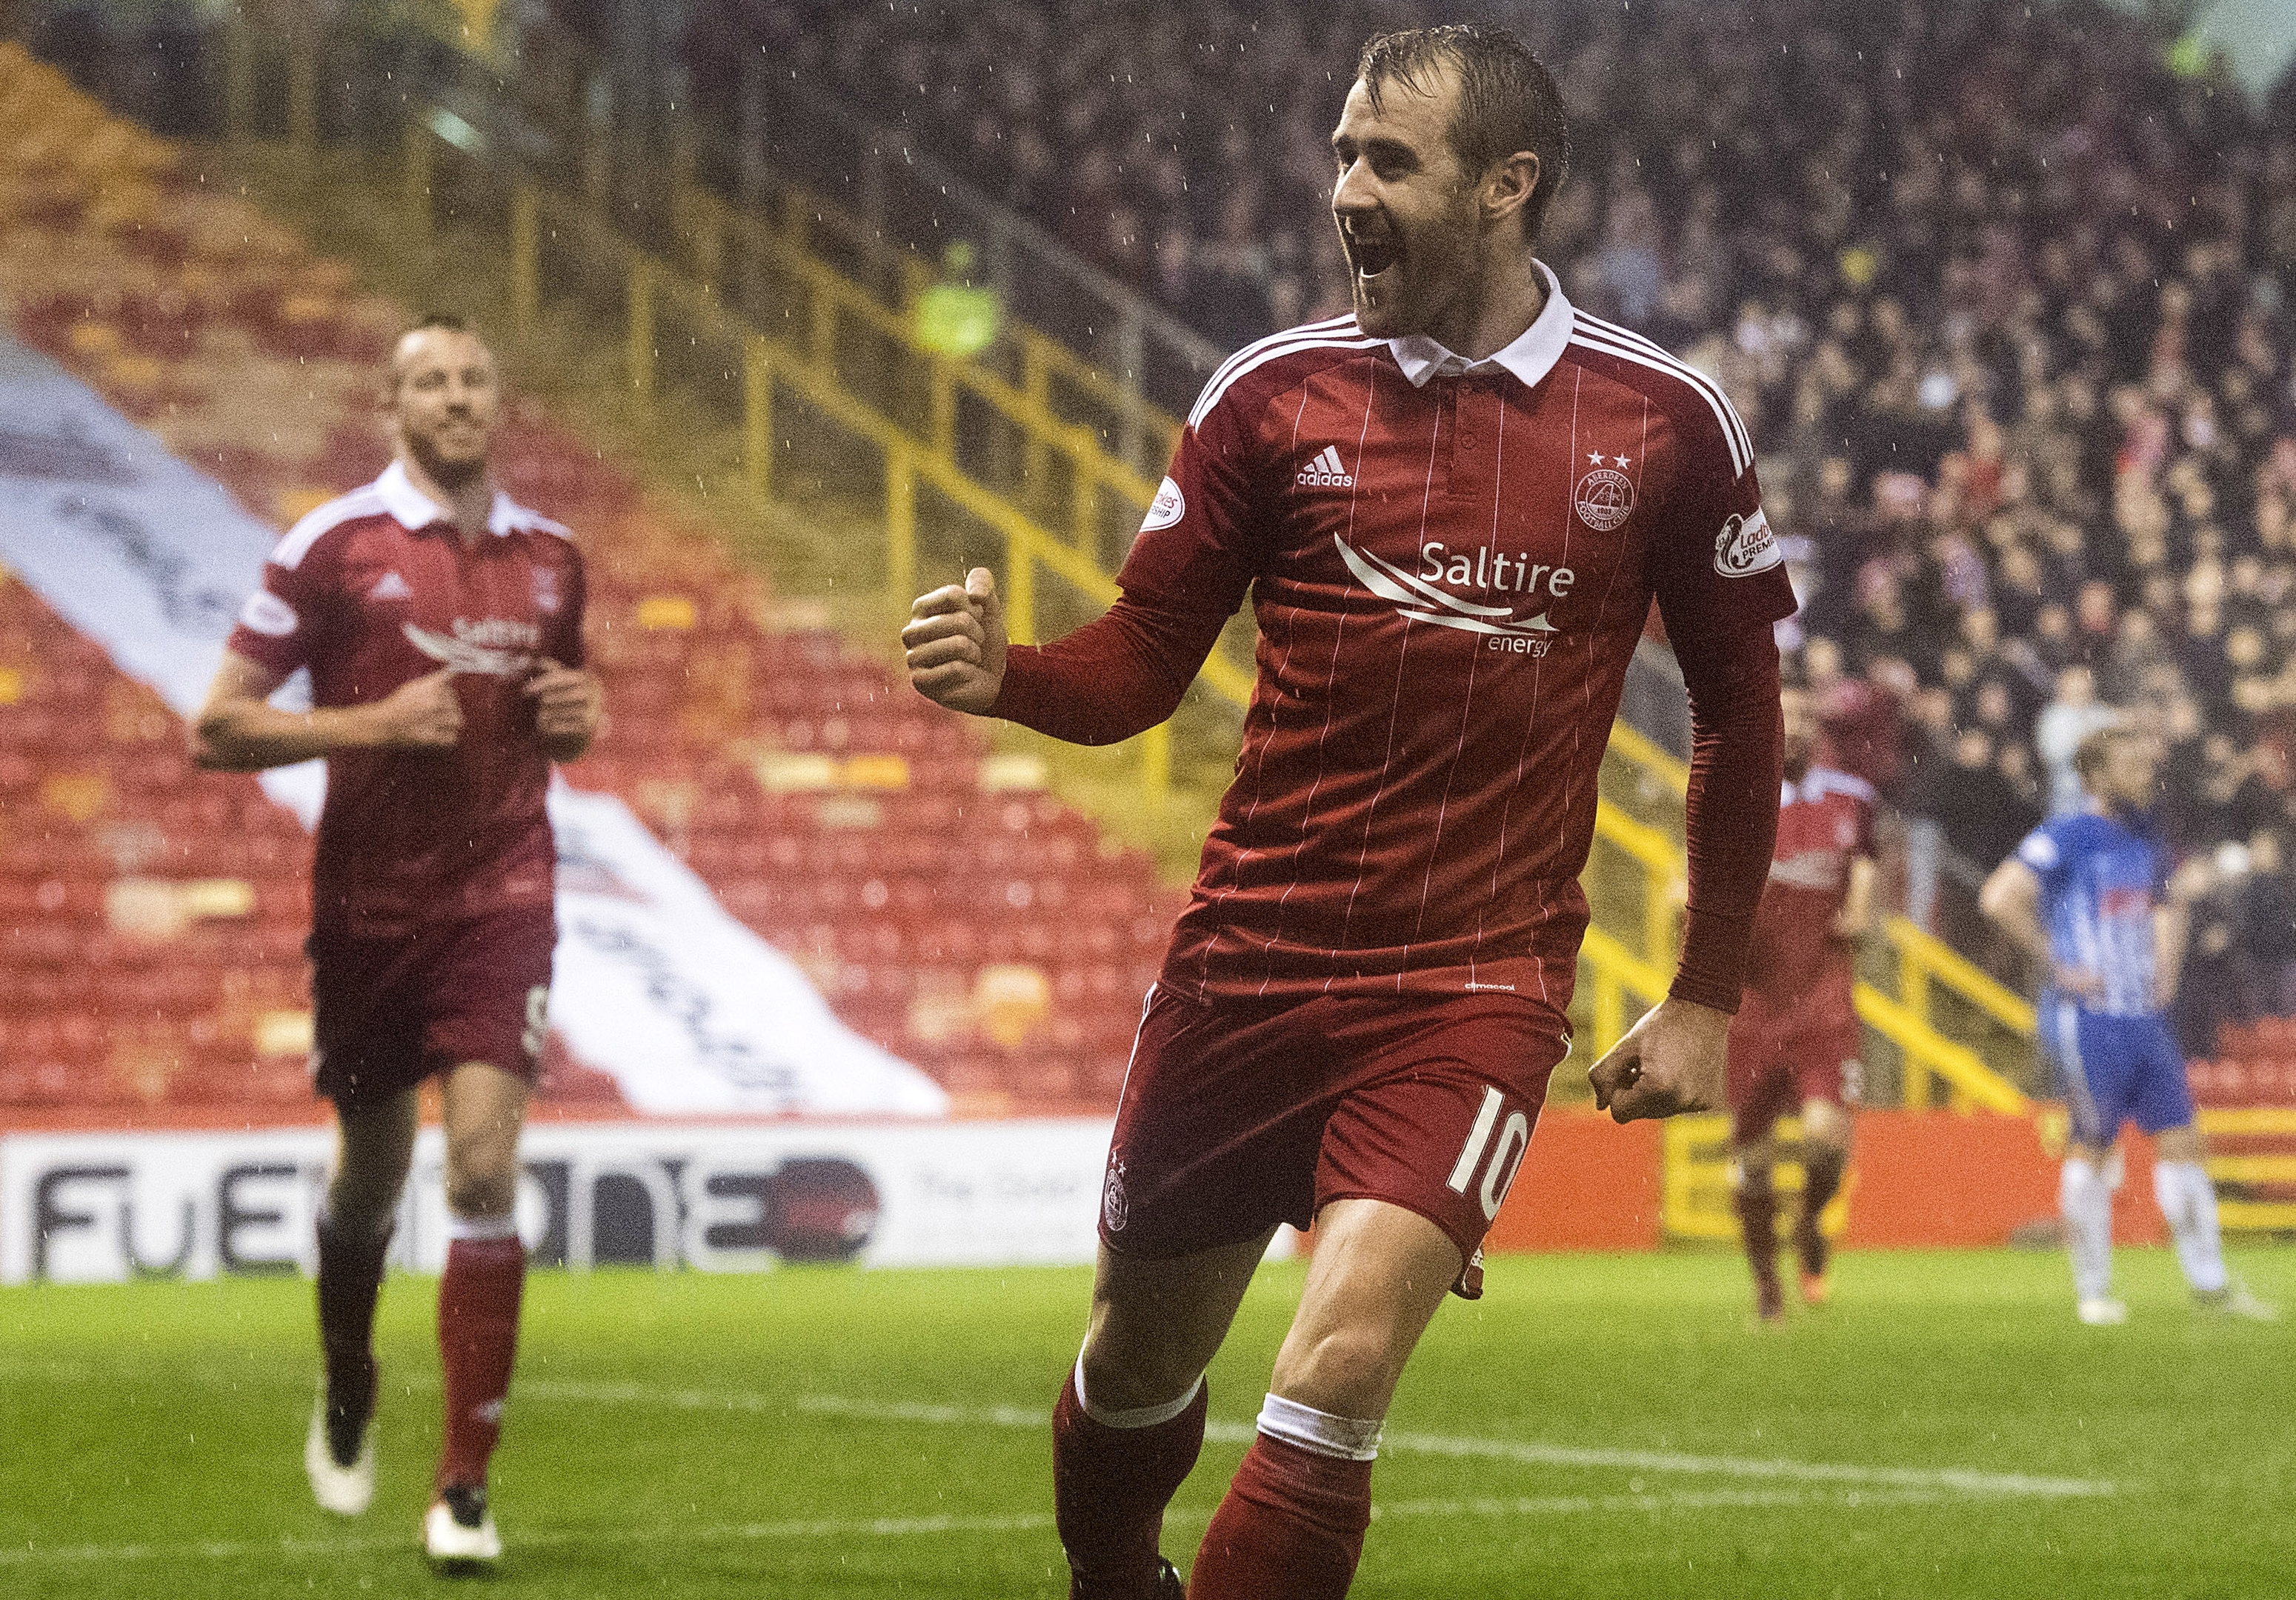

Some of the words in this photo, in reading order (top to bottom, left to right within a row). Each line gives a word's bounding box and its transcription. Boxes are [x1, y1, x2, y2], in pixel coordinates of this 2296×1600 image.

[1297, 471, 1353, 487] adidas
[1587, 472, 1628, 490] ABERDEEN
[1577, 501, 1613, 530] FOOTBALL
[1613, 505, 1631, 525] CLUB
[1420, 541, 1575, 597] Saltire
[1488, 636, 1553, 658] energy
[1465, 982, 1515, 991] climacool
[1446, 1084, 1528, 1221] 10
